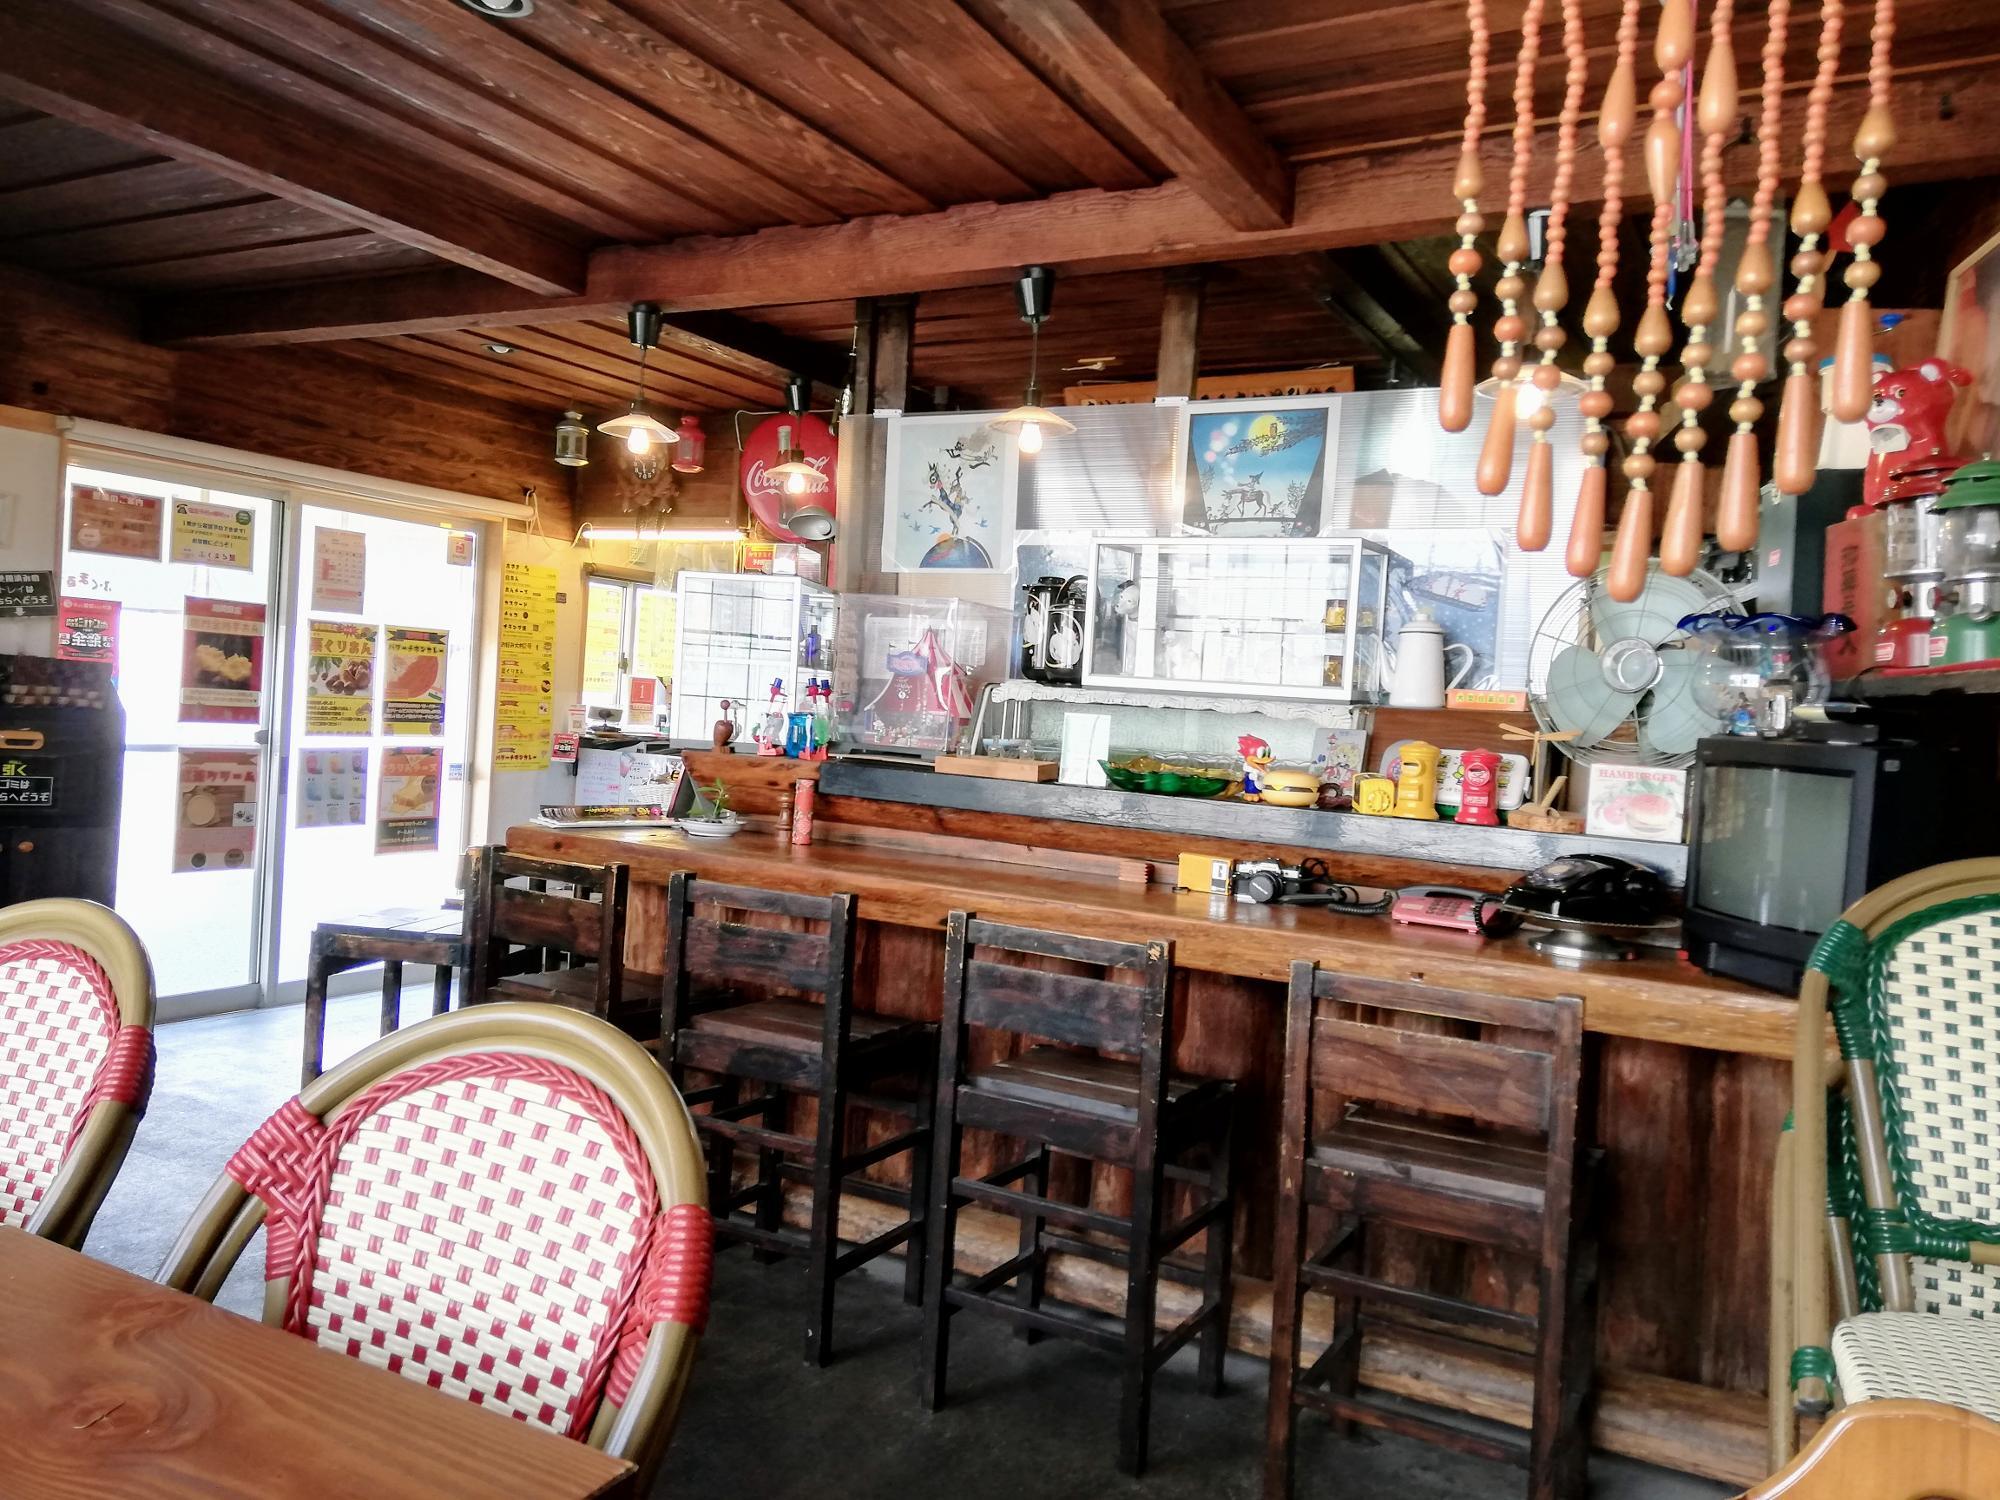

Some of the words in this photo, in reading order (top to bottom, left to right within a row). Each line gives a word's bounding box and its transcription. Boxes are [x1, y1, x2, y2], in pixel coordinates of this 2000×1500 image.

[746, 456, 830, 496] Coca-Cla
[2, 764, 28, 776] 引く
[1599, 769, 1678, 783] HAMBURGER
